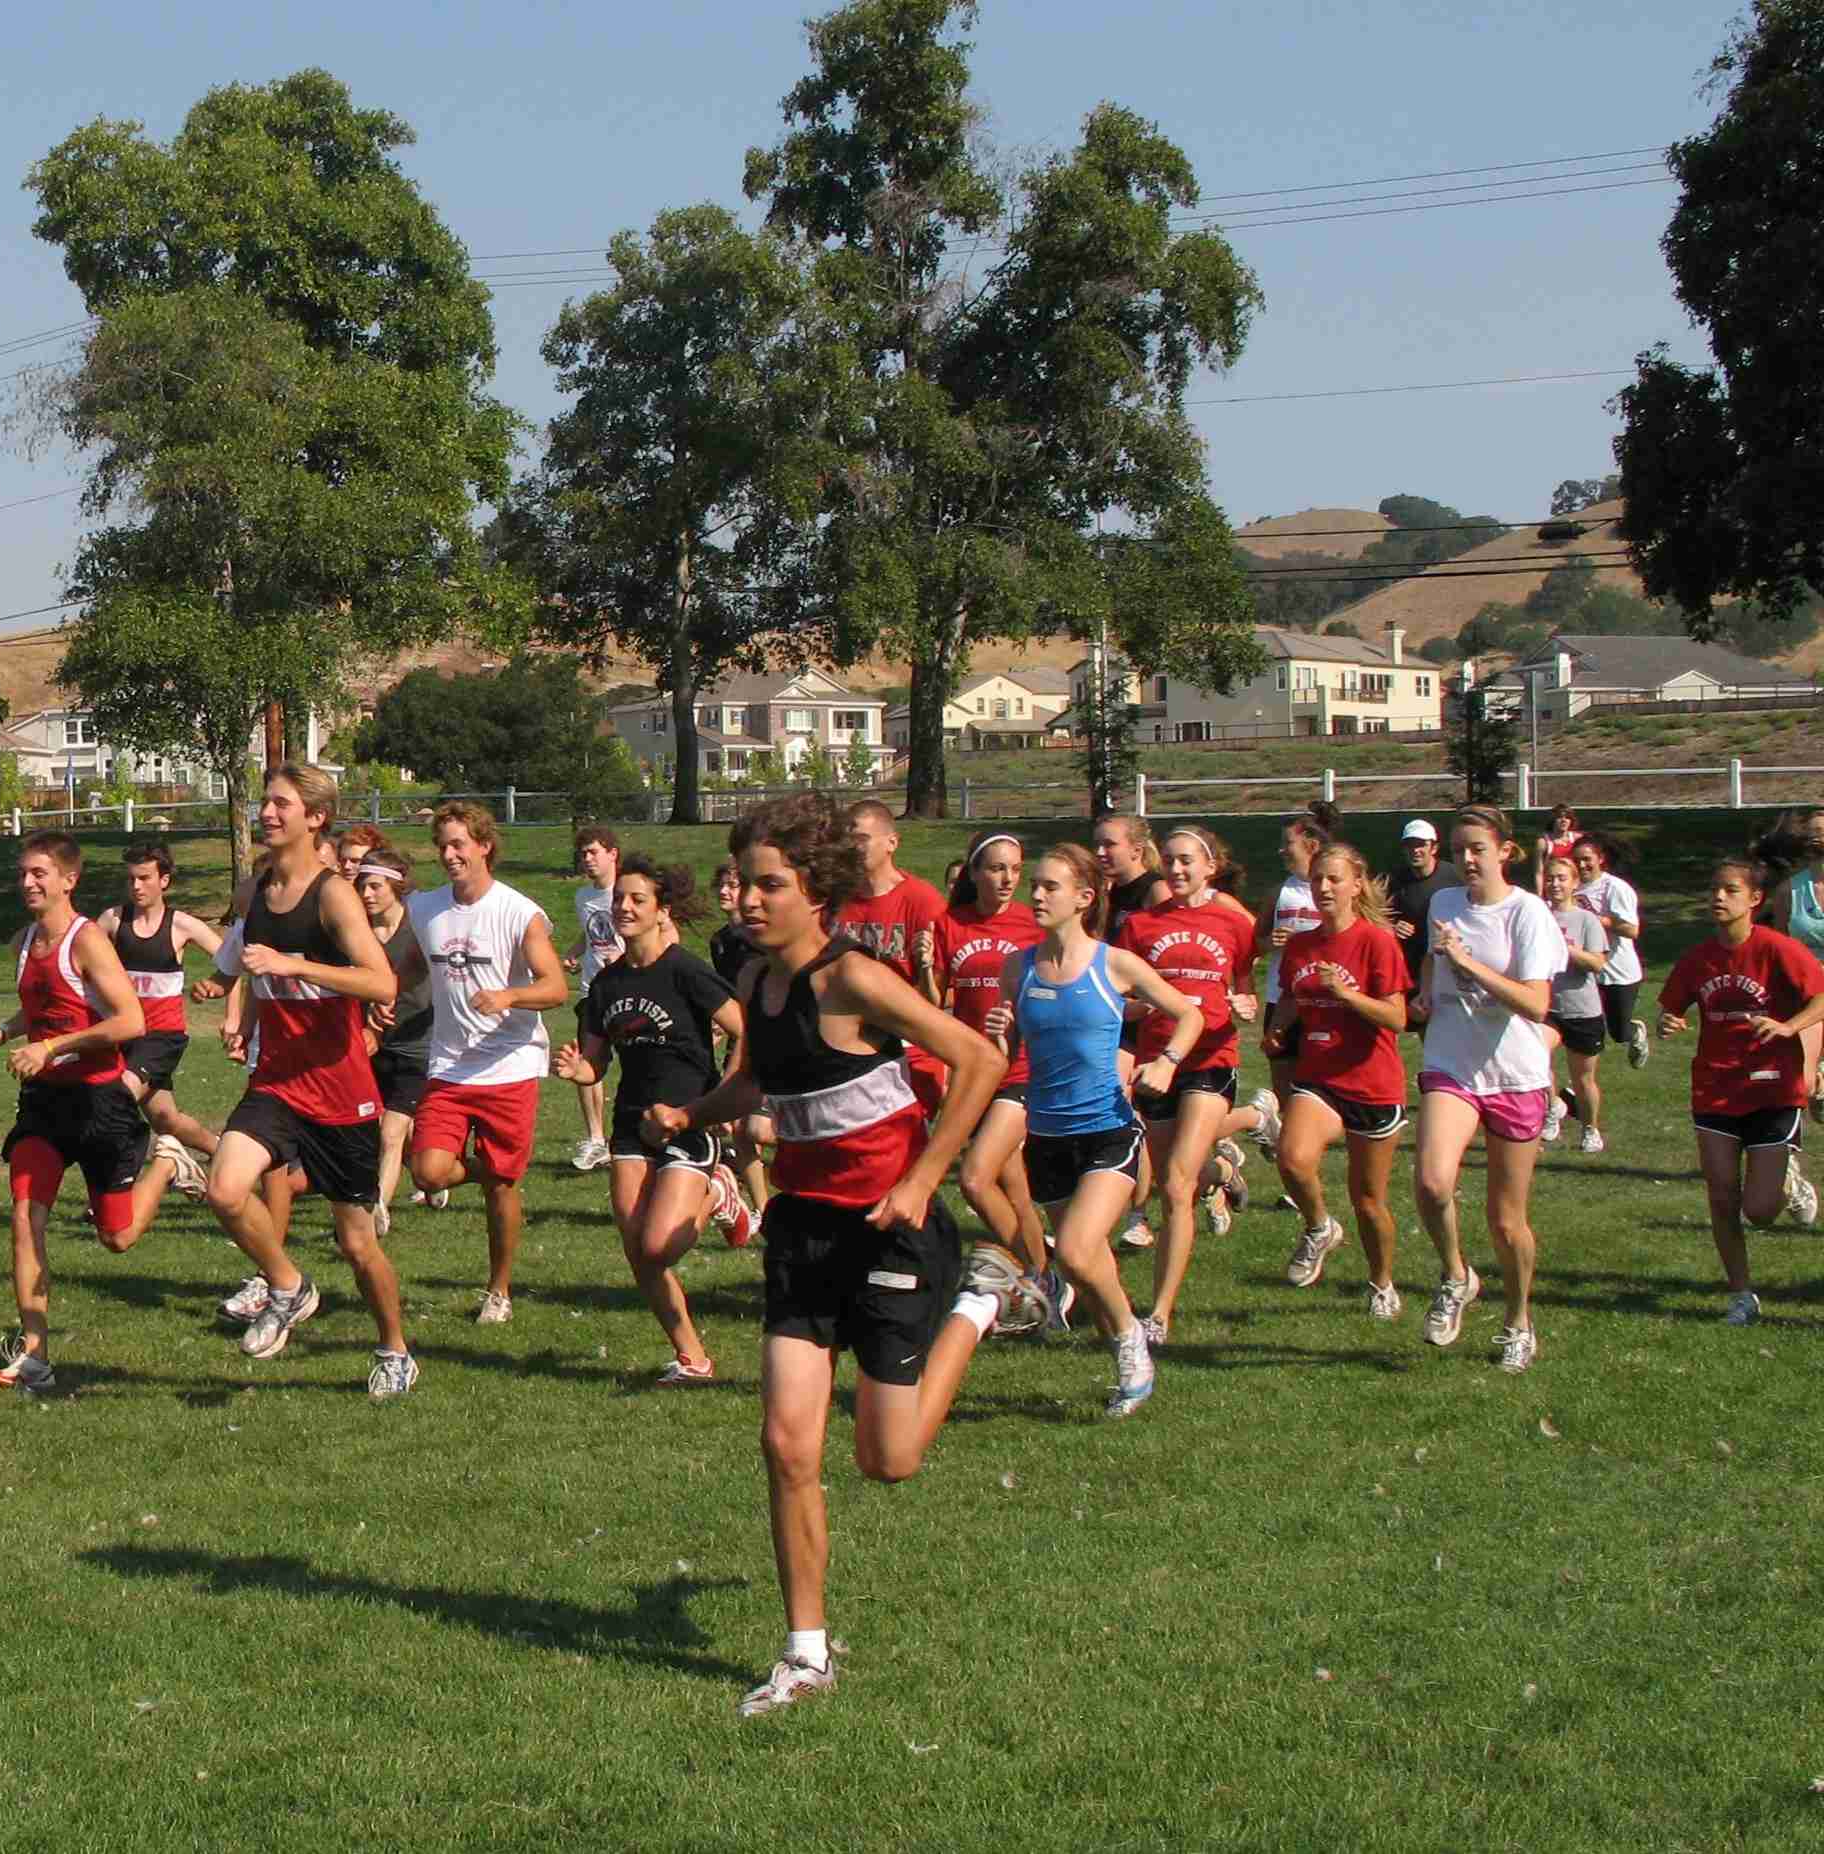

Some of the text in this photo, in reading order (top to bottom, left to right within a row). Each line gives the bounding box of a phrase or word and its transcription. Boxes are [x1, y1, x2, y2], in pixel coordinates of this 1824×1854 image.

[951, 938, 993, 973] MONTE
[1149, 931, 1228, 967] MONTE VISTA
[638, 997, 674, 1032] VISTA
